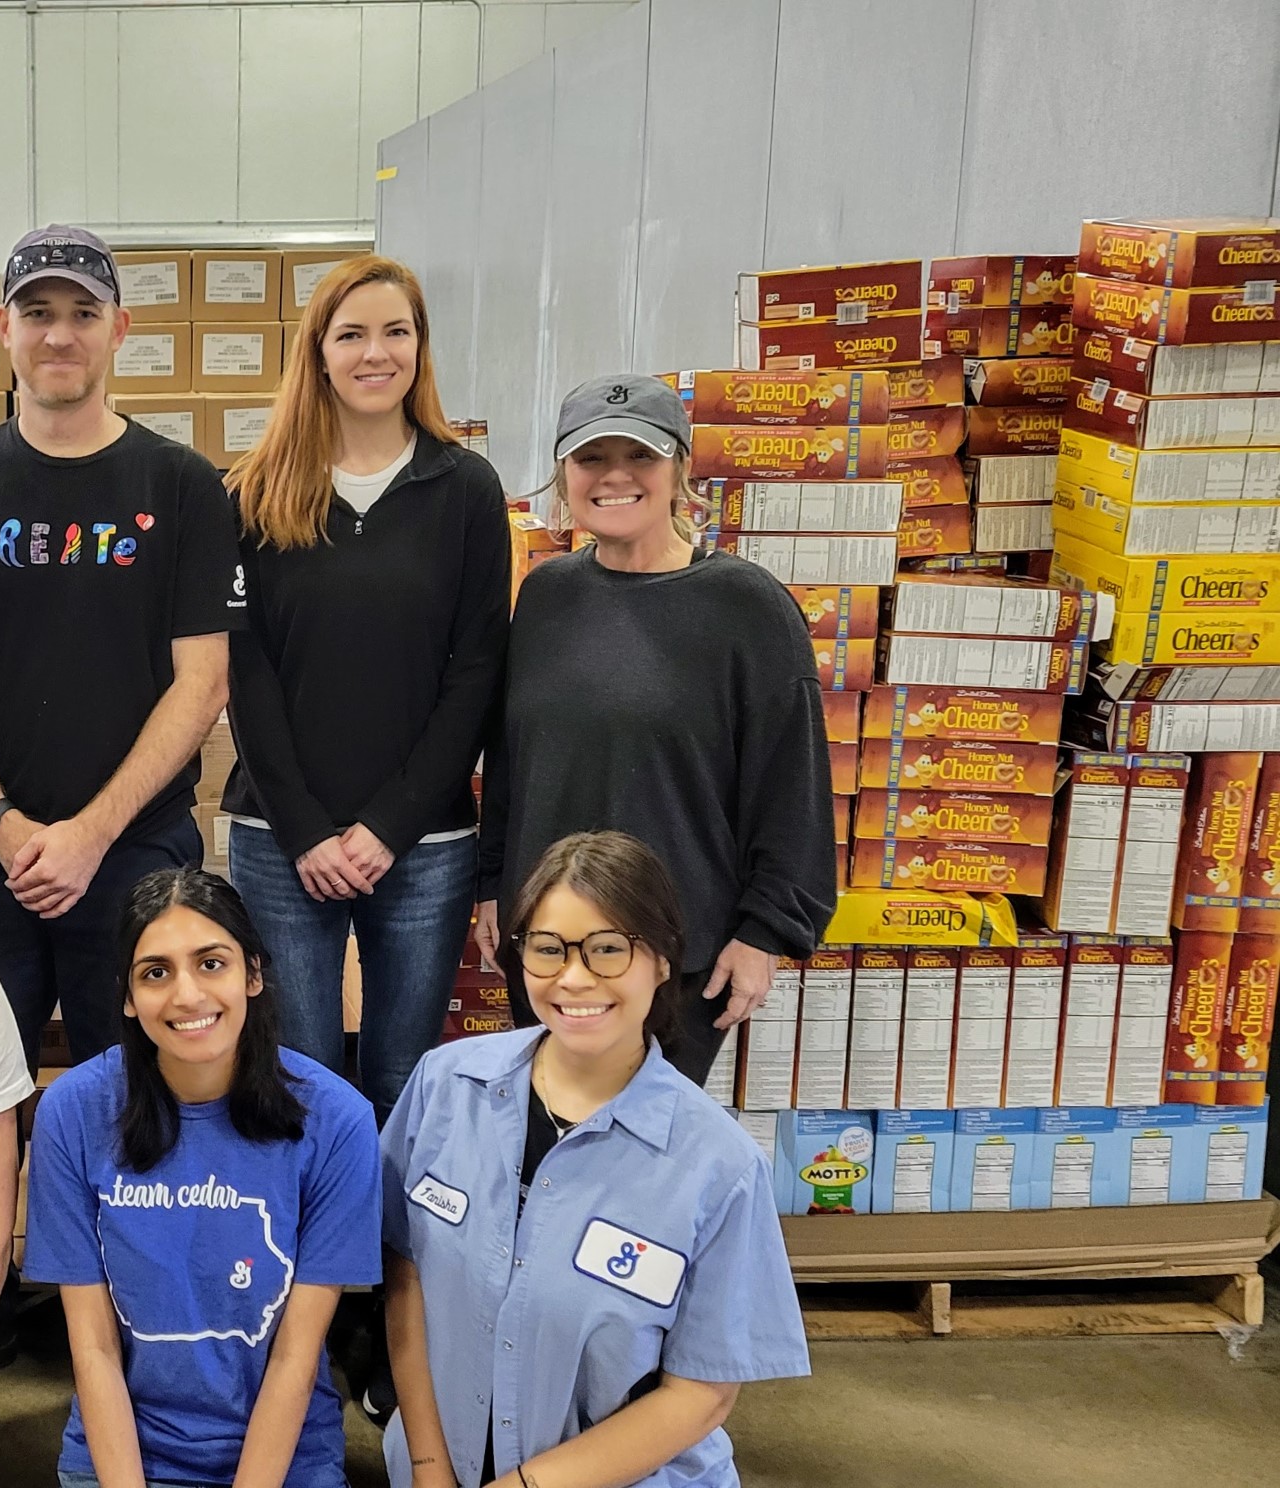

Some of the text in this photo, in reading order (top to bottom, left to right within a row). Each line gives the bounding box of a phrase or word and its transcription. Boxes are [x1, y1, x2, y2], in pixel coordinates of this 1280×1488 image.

[724, 382, 812, 407] Cheerios
[736, 403, 782, 414] Honey Nut
[723, 437, 810, 460] Cheerios
[734, 458, 780, 467] Honey Nut
[1181, 575, 1269, 599] Cheerios
[1172, 628, 1260, 651] Cheerios
[972, 700, 1018, 712] Honey Nut
[943, 706, 1028, 732] Cheerios
[968, 752, 1014, 763] Honey Nut
[938, 757, 1024, 783] Cheerios
[964, 802, 1010, 814] Honey Nut
[935, 808, 1019, 833] Cheerios
[1211, 780, 1247, 861] Cheerios
[961, 853, 1006, 864] Honey Nut
[931, 859, 1016, 884] Cheerios
[882, 908, 966, 932] Cheerios
[1189, 958, 1219, 1037] Cheerios
[1240, 959, 1270, 1037] Cheerios
[107, 1174, 241, 1210] team cedar
